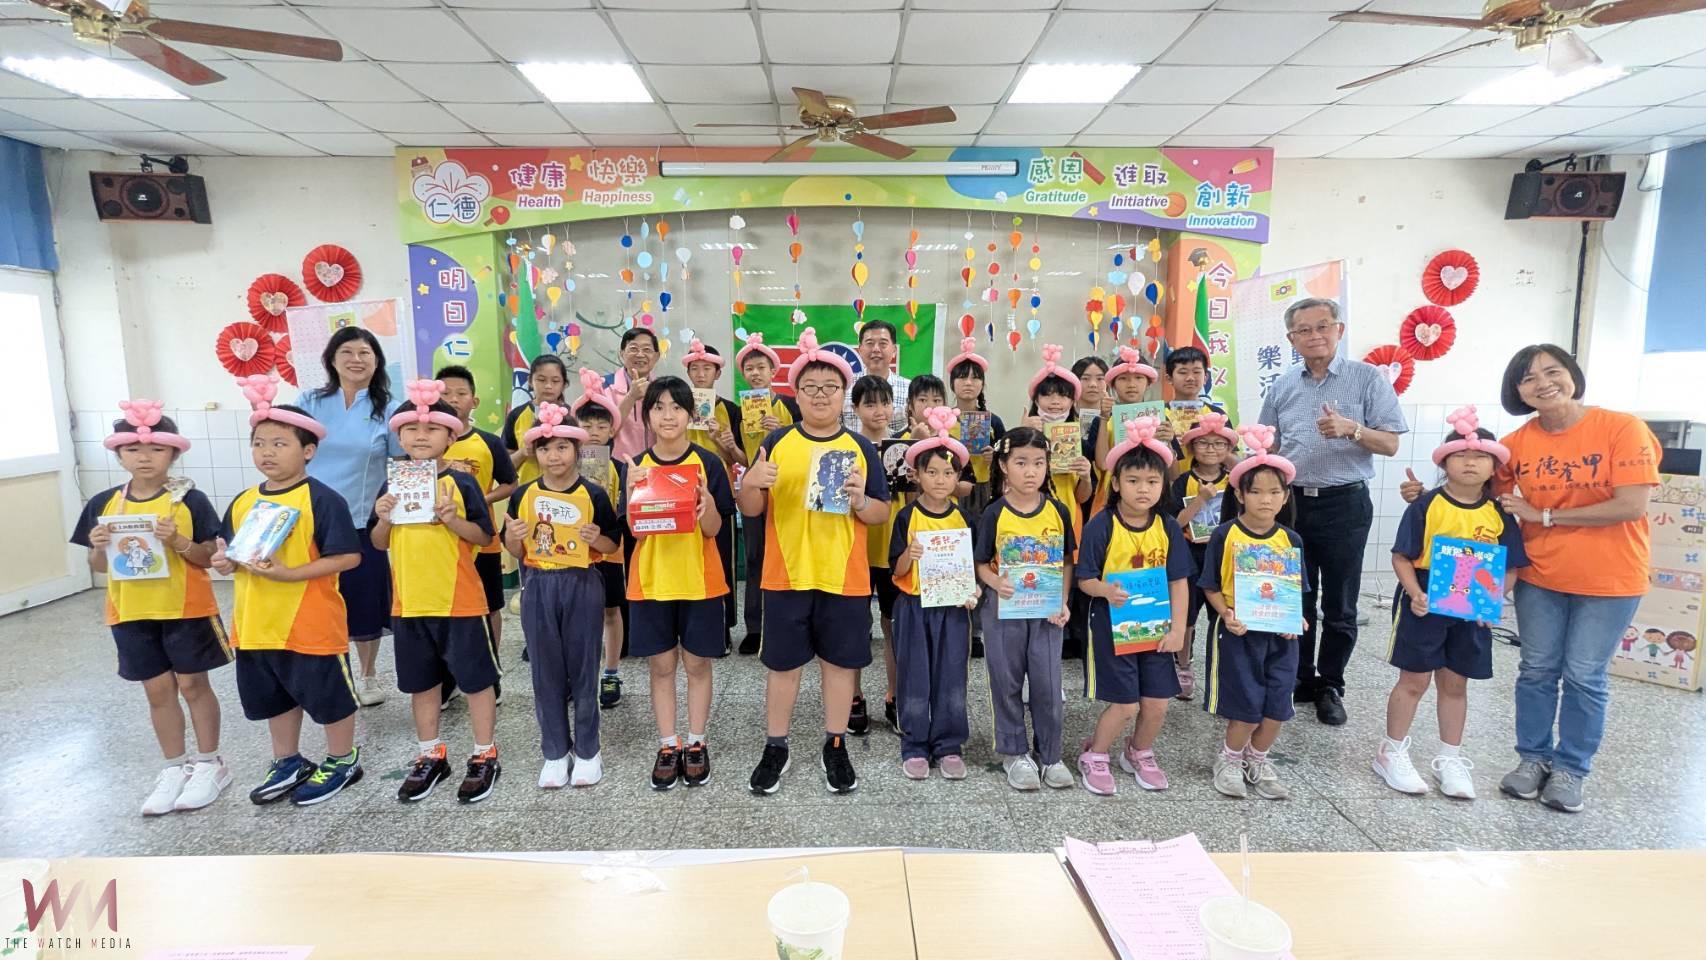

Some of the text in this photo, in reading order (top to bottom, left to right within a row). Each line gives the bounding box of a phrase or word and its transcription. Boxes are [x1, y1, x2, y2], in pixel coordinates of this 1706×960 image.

[510, 162, 566, 188] 健康
[589, 157, 647, 185] 快樂
[1030, 158, 1084, 183] 感恩
[1114, 164, 1168, 186] 進取
[518, 196, 561, 208] Health
[584, 191, 651, 205] Happiness
[1025, 190, 1086, 203] Gratitude
[1111, 195, 1168, 208] Initiative
[1197, 182, 1250, 208] 創新
[428, 196, 476, 219] 仁德
[1188, 215, 1255, 227] Innovation
[440, 268, 470, 355] 明日仁
[1208, 262, 1232, 405] 今日我以
[1653, 512, 1674, 525] 小
